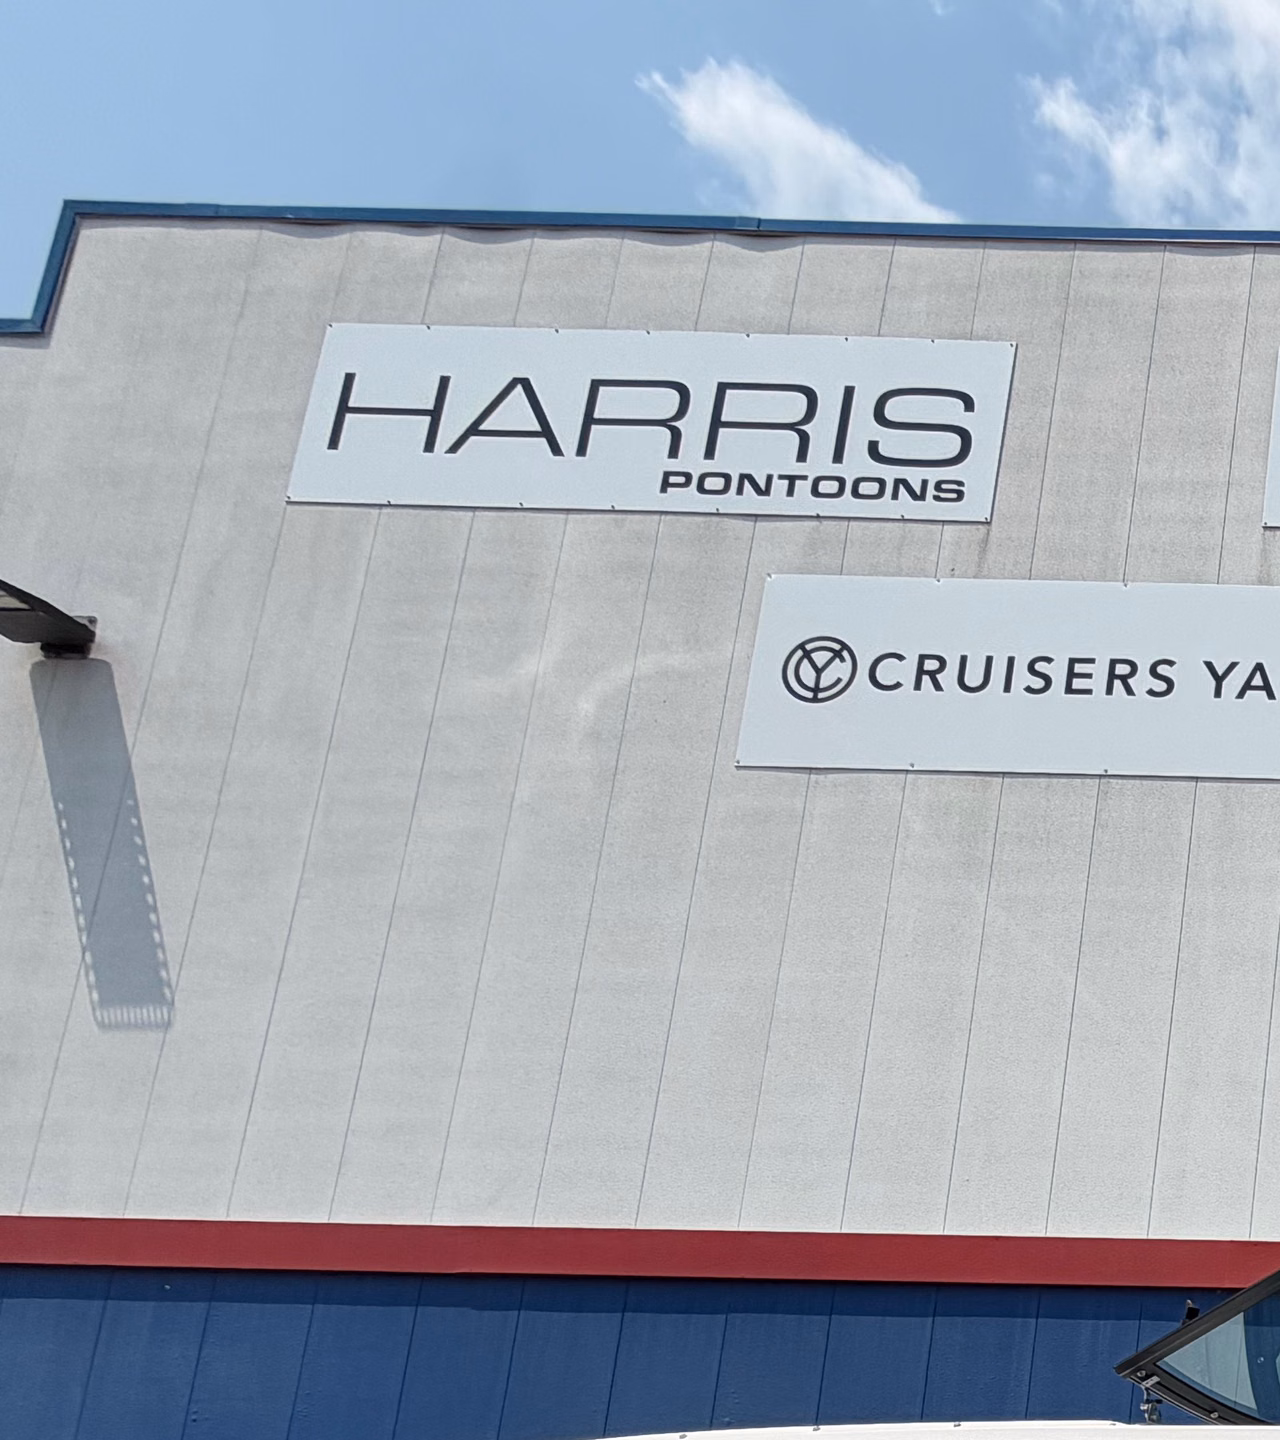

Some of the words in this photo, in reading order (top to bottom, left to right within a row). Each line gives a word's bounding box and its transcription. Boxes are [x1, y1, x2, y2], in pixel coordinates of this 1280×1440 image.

[327, 372, 975, 468] HARRIS
[659, 470, 966, 503] PONTOONS
[868, 652, 1177, 698] CRUISERS
